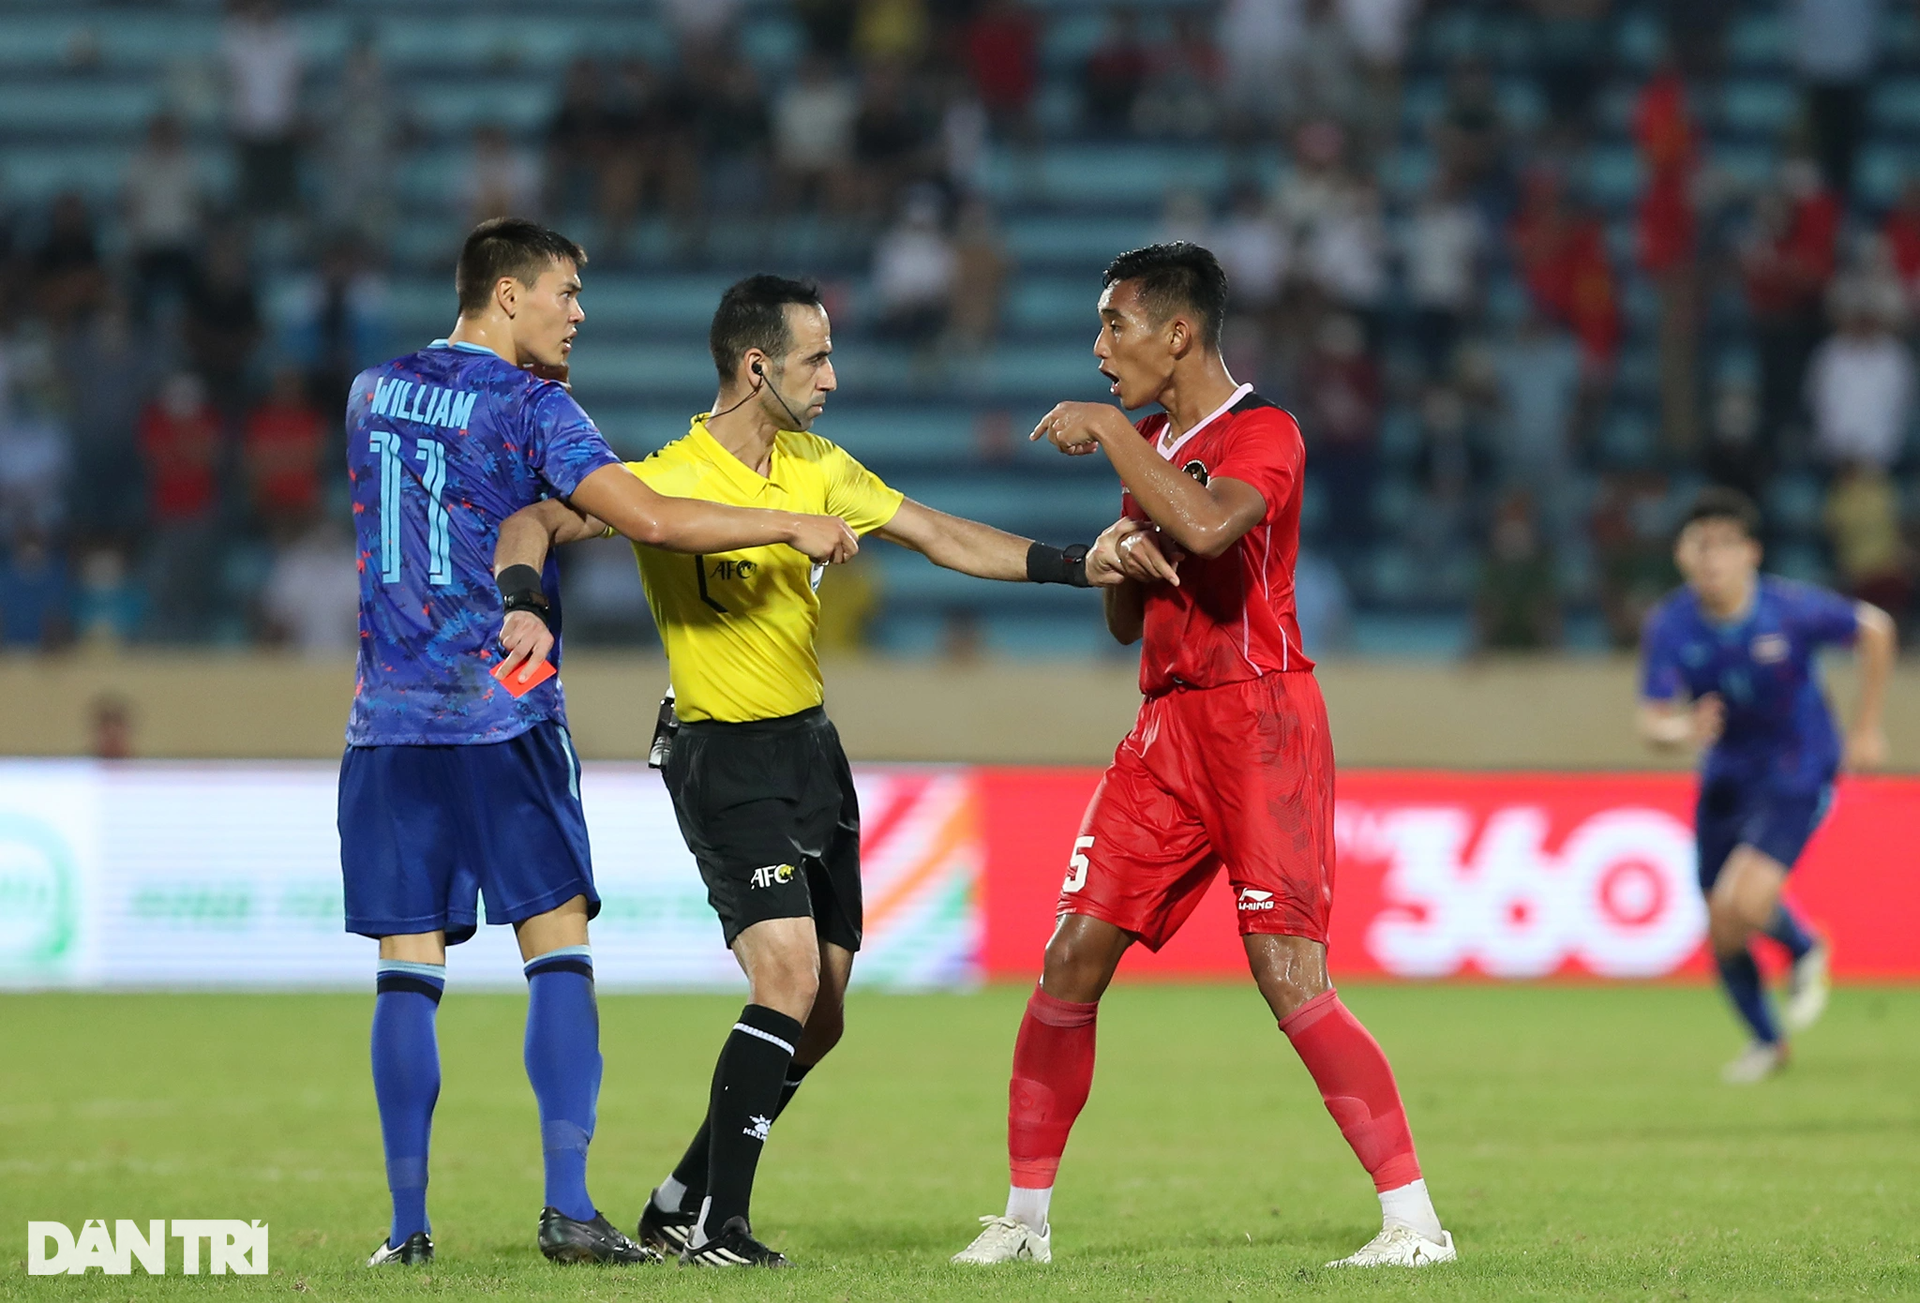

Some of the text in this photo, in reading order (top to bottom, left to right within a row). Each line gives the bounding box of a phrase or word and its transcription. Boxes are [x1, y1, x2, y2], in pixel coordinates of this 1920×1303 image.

[370, 376, 478, 430] WILLIAM
[369, 430, 451, 586] 11
[710, 559, 757, 580] AFC
[750, 863, 795, 890] AFC
[1062, 835, 1096, 893] 5
[1366, 805, 1710, 979] 360
